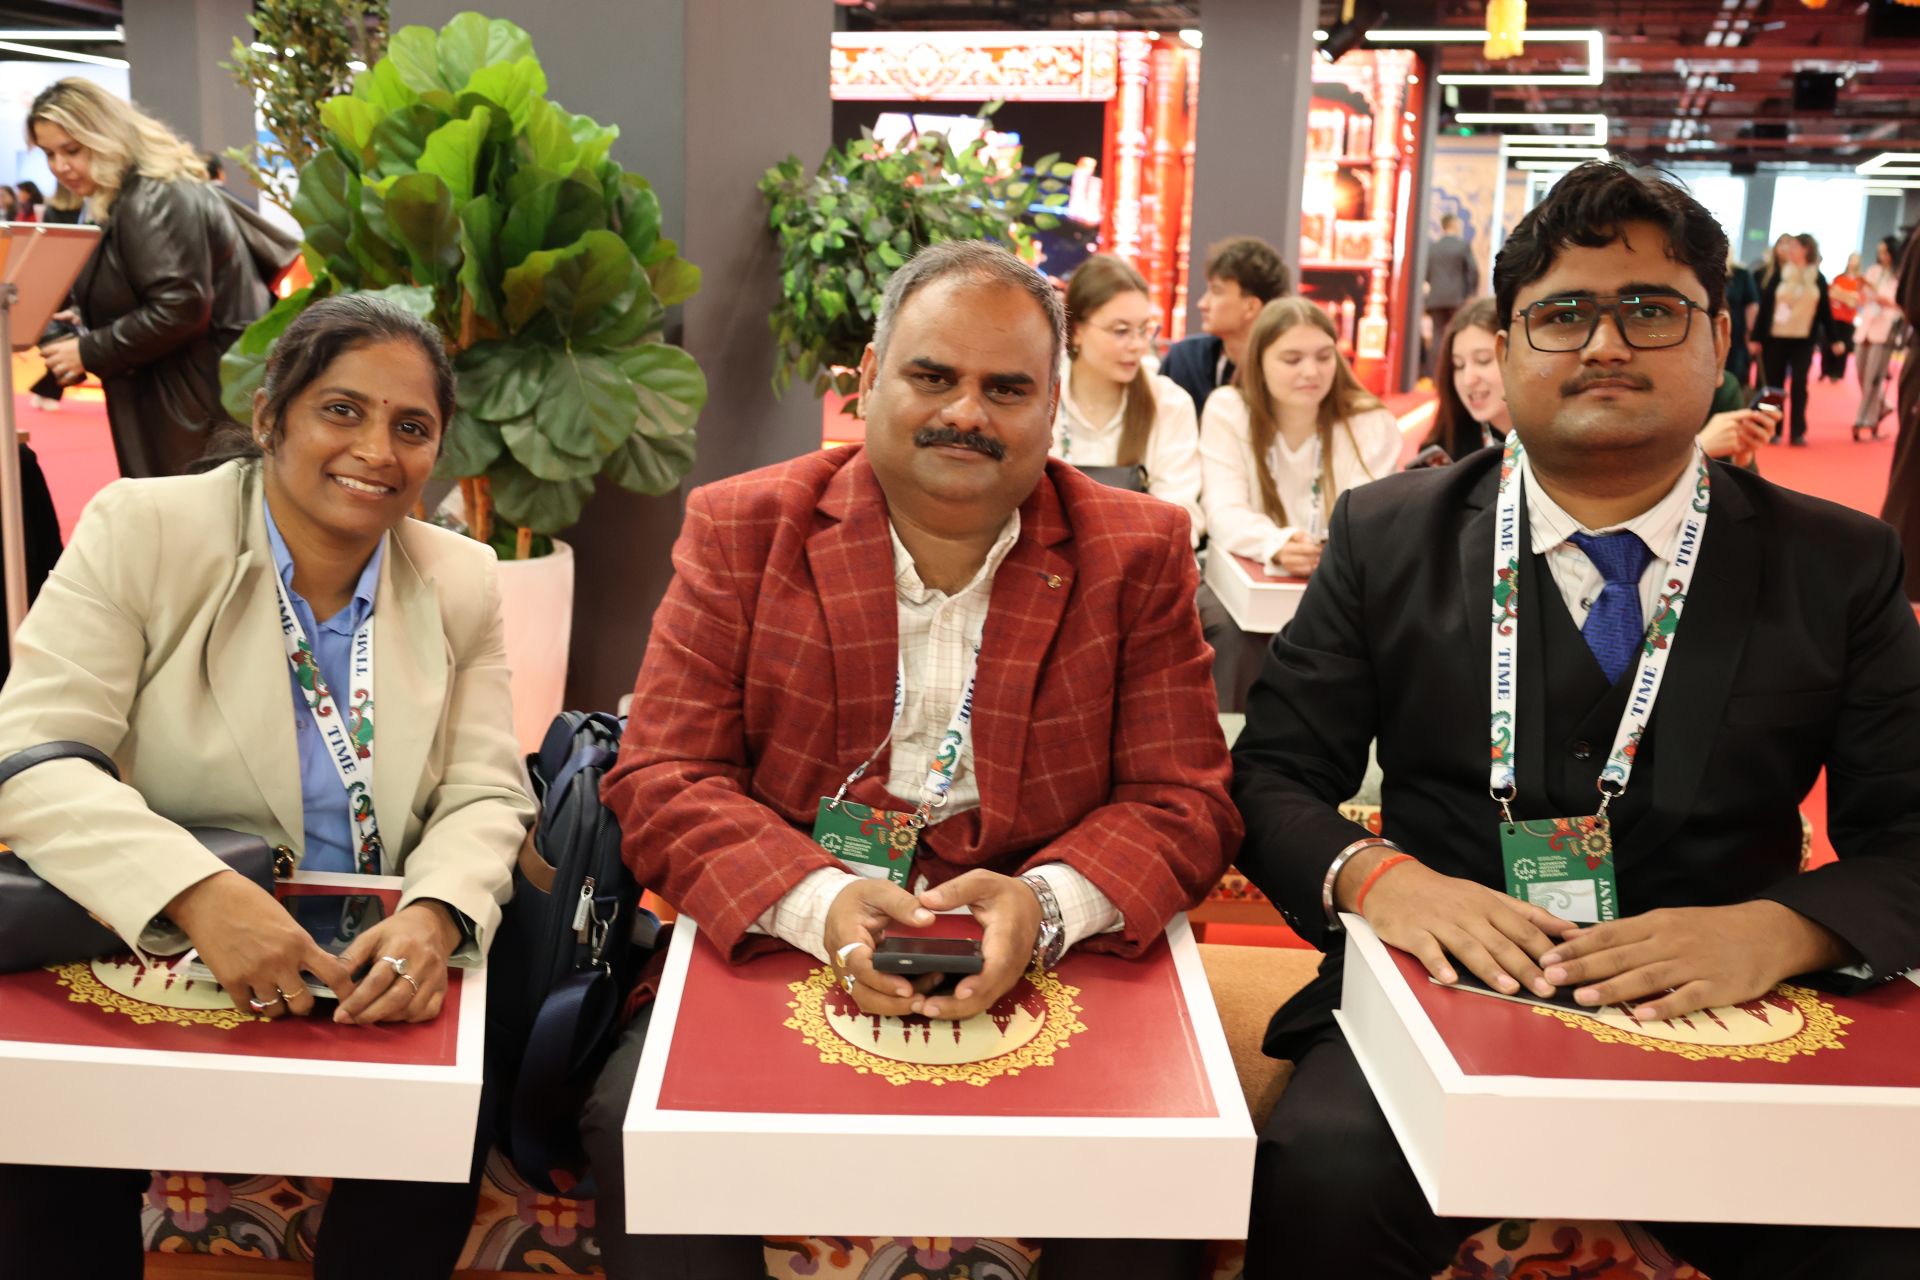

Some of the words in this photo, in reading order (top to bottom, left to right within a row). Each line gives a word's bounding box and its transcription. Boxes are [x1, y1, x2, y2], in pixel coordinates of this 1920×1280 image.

[1501, 504, 1514, 550] TIME
[1675, 519, 1699, 566] TIME
[1497, 647, 1511, 700] TIME
[1630, 665, 1657, 716] TIME
[328, 724, 357, 774] TIME
